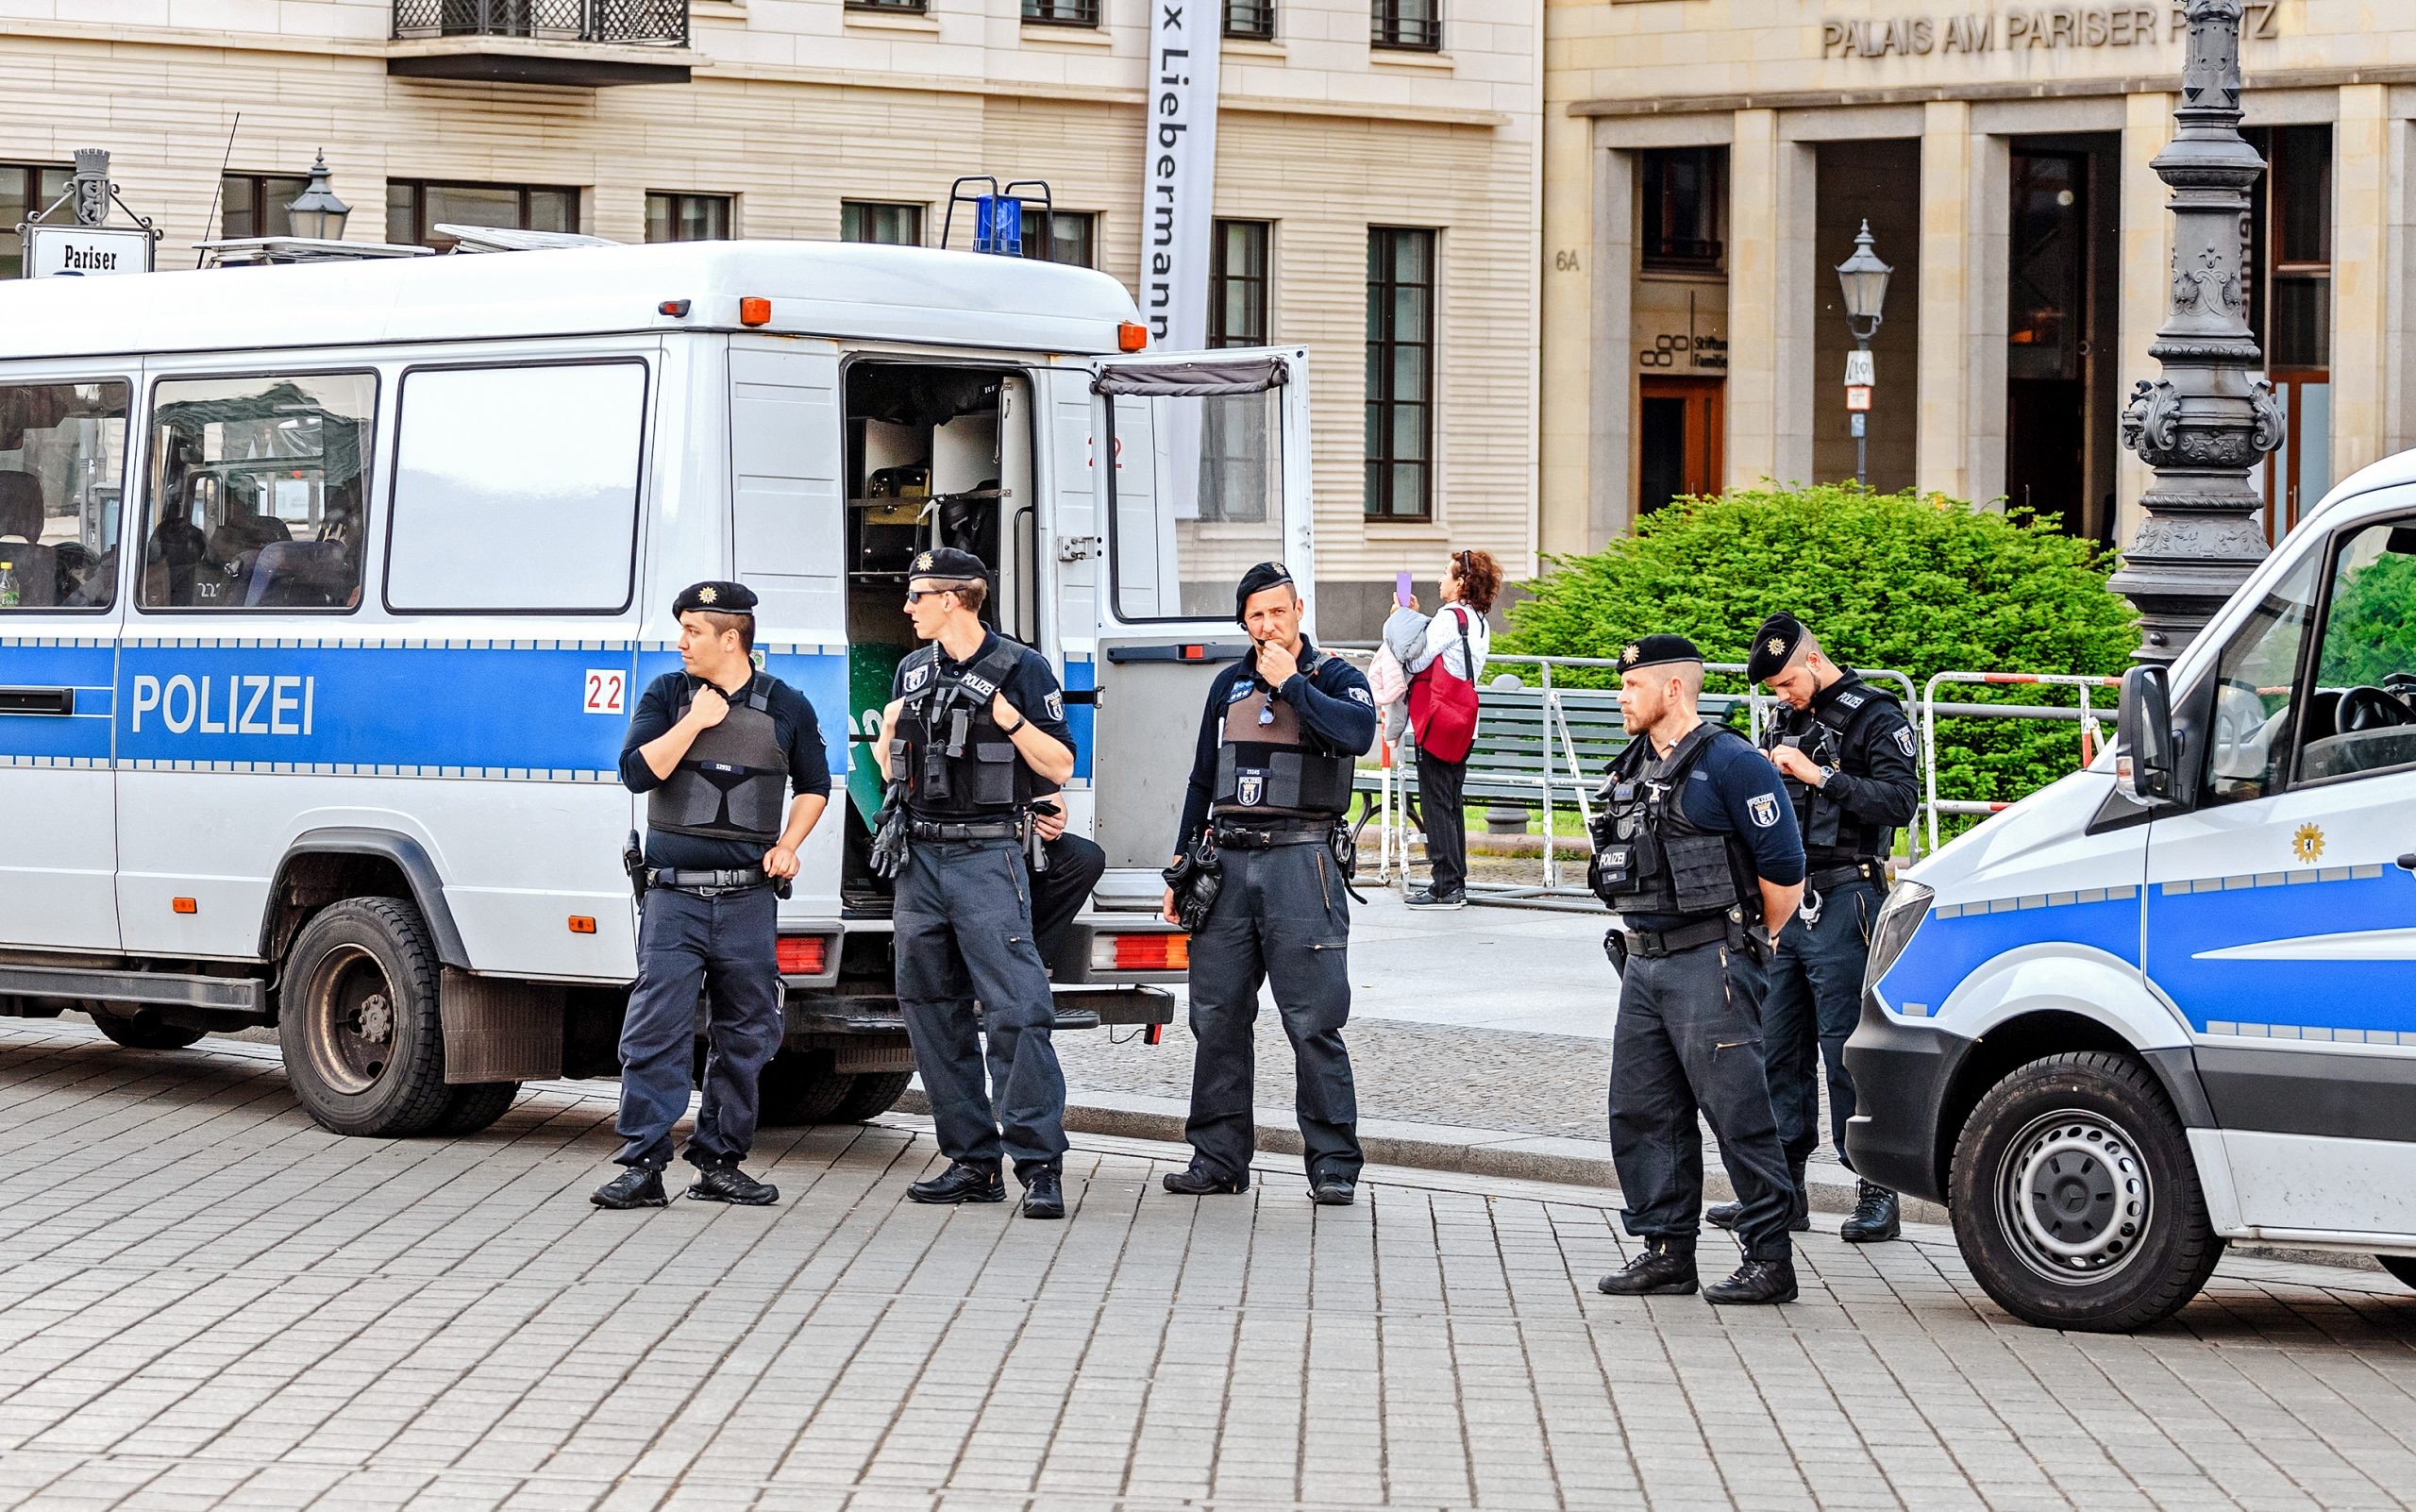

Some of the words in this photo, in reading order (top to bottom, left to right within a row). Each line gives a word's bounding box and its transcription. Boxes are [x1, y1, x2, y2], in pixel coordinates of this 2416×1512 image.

[1821, 19, 1934, 59] PALAIS
[1941, 14, 1994, 54] AM
[2007, 8, 2157, 48] PARISER
[1149, 48, 1189, 343] Liebermann
[64, 244, 117, 270] Pariser
[1555, 250, 1580, 272] 6A
[132, 674, 314, 735] POLIZEI
[588, 675, 621, 708] 22
[1599, 851, 1626, 868] POLIZEI
